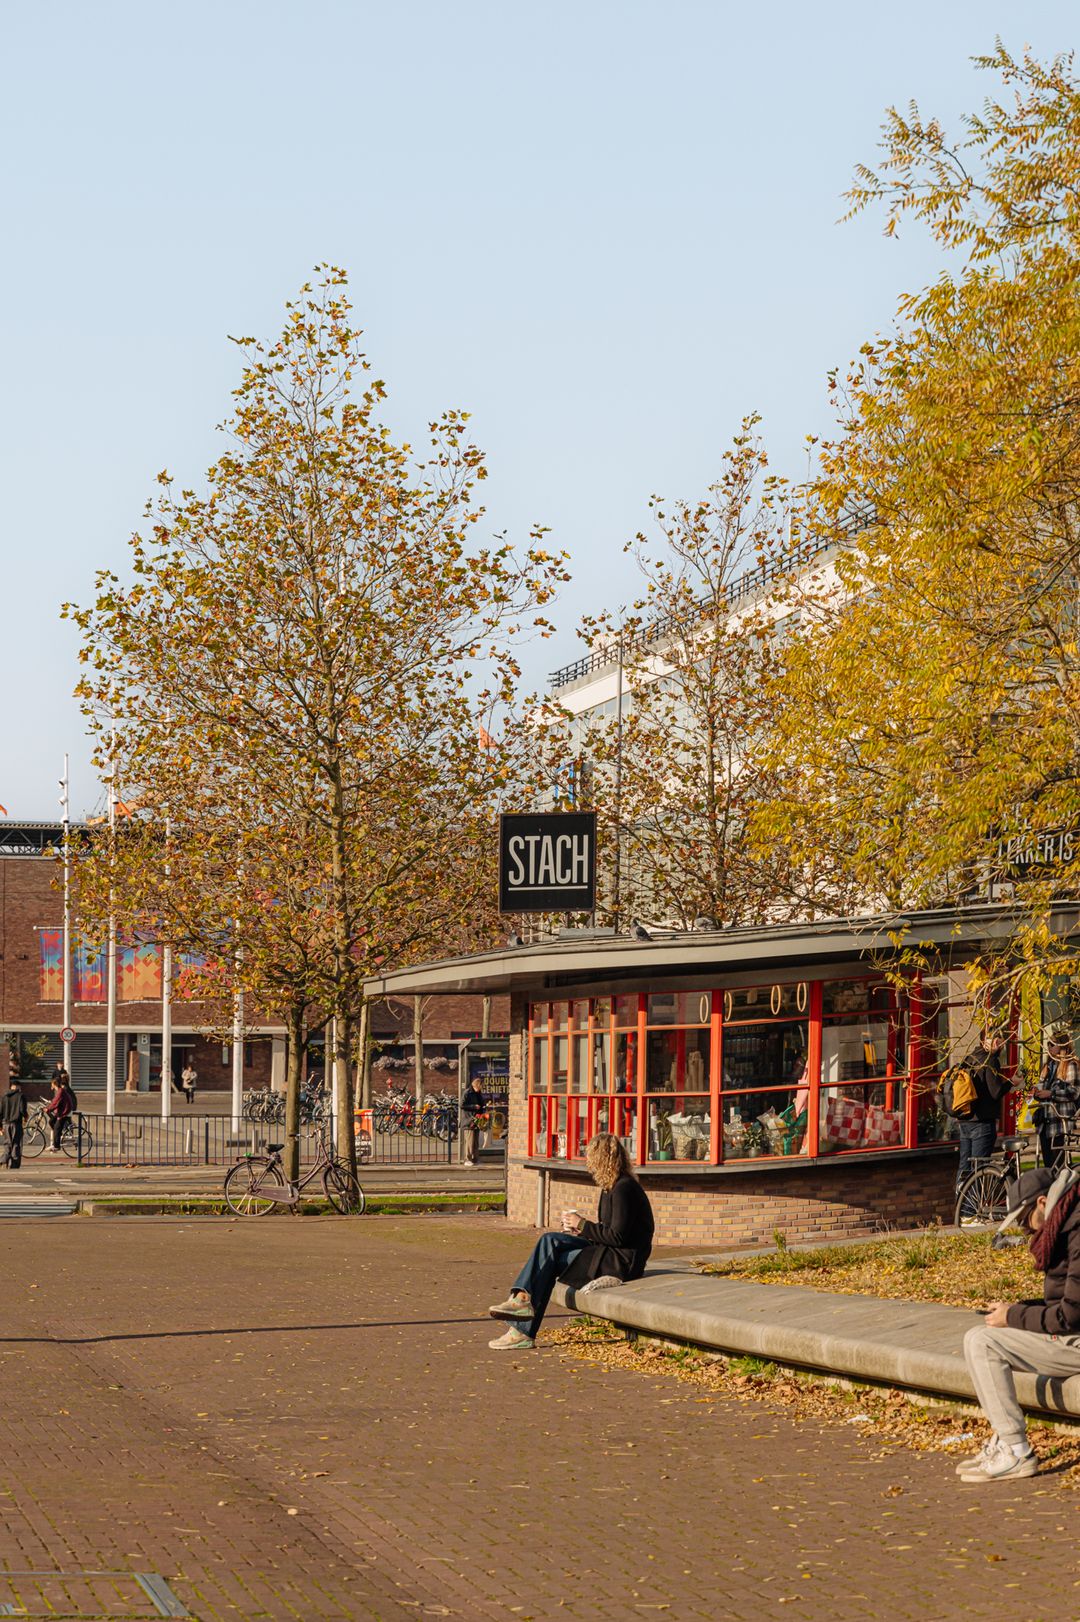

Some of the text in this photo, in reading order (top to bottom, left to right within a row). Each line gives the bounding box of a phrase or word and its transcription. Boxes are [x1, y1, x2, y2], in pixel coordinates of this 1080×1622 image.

[1058, 832, 1074, 861] IS
[508, 834, 589, 885] STACH
[141, 1034, 148, 1044] B
[481, 1085, 509, 1094] GENIET
